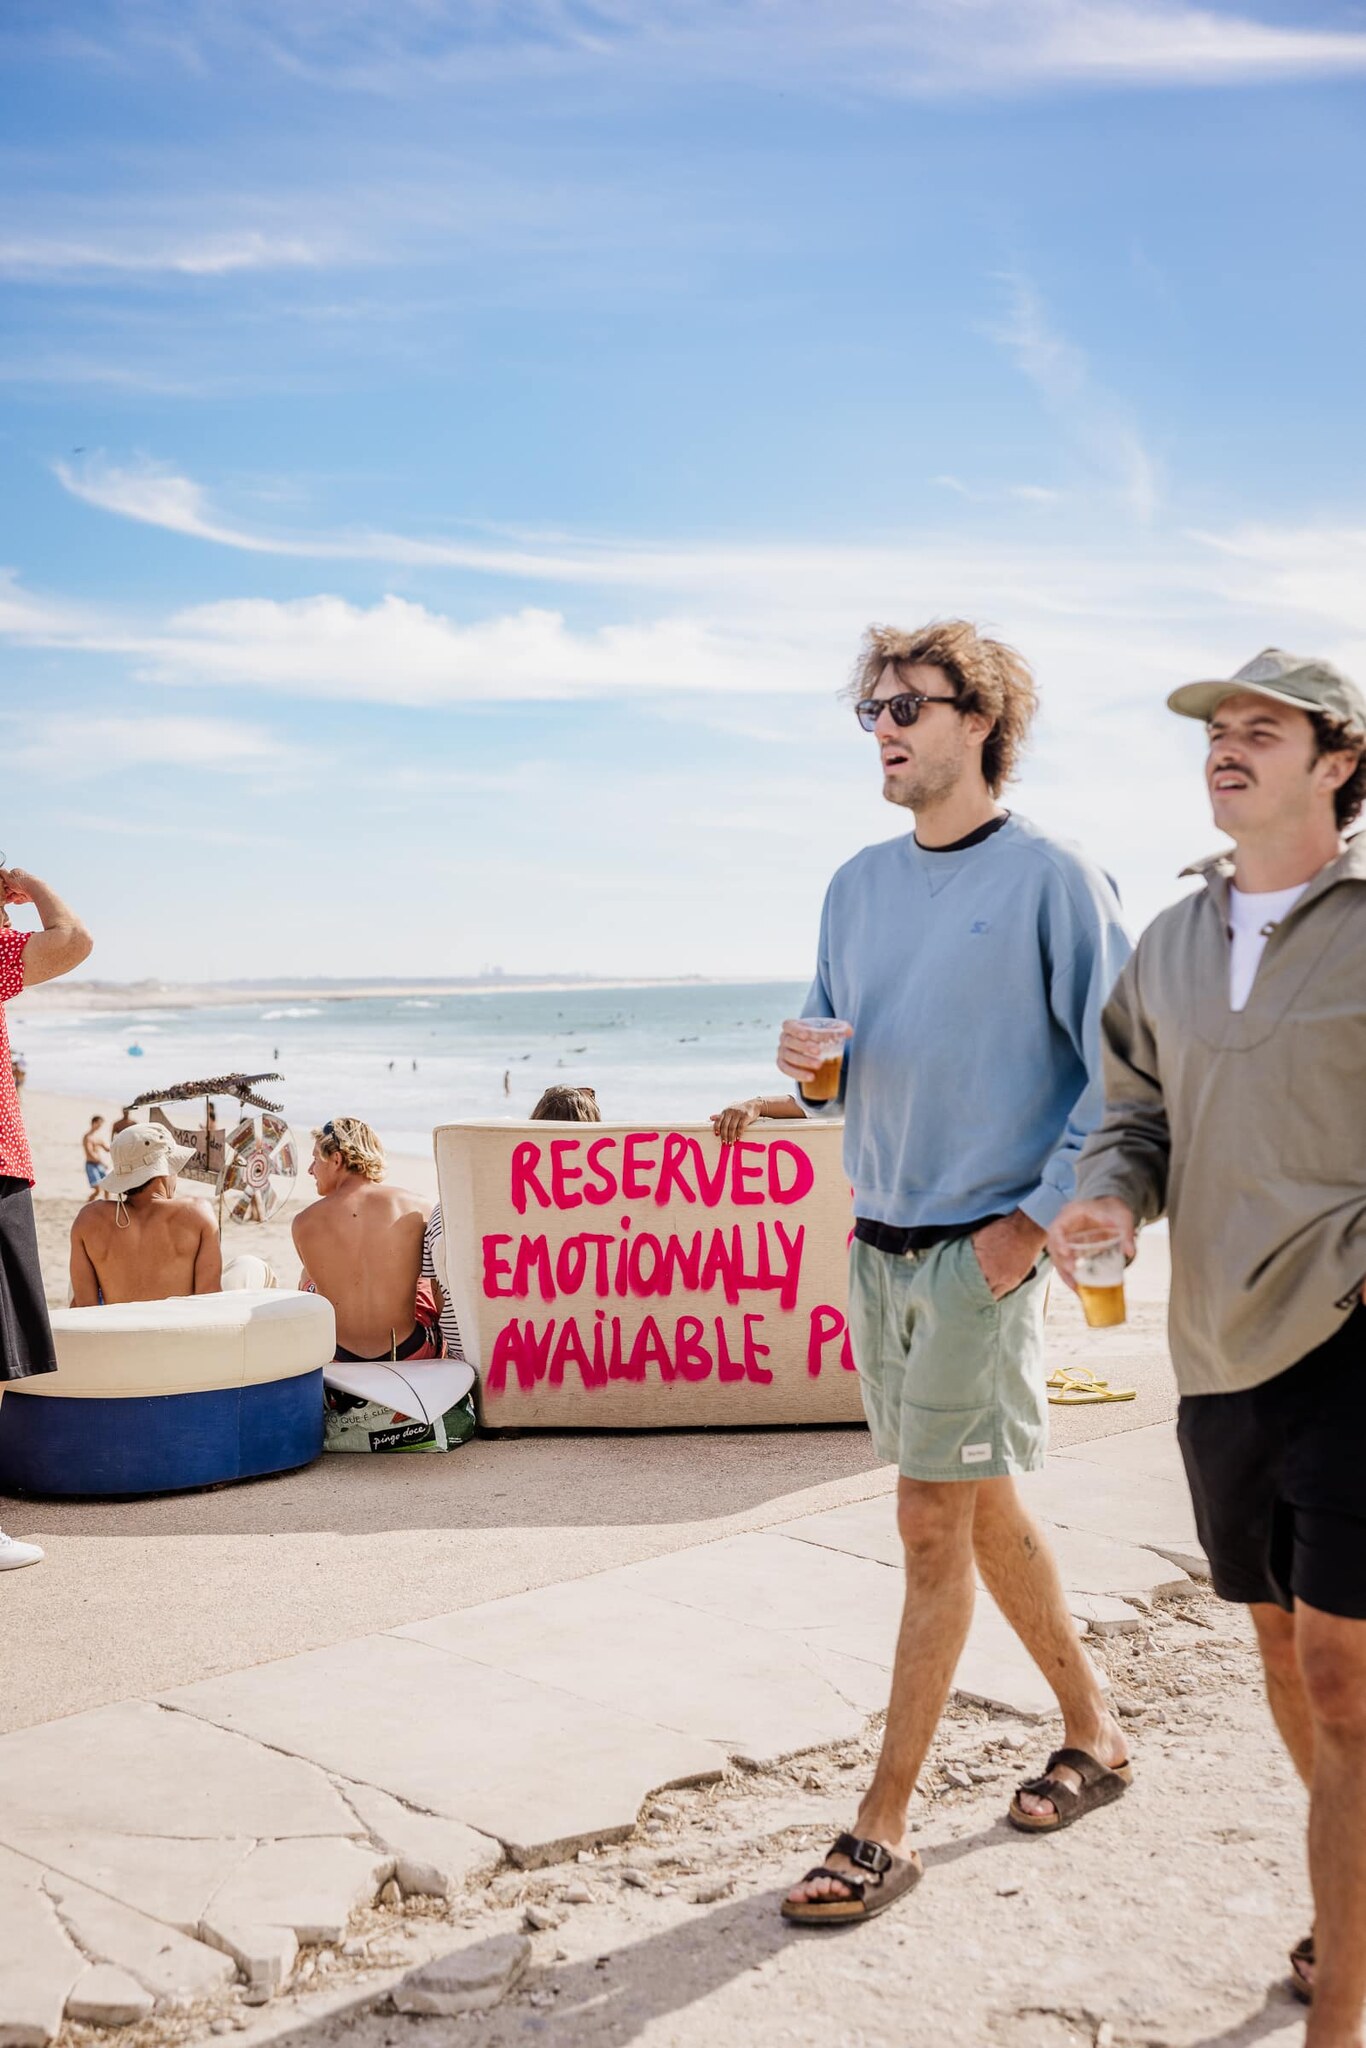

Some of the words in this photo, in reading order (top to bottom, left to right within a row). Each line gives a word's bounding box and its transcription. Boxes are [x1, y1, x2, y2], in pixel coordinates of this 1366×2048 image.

[511, 1132, 814, 1214] RESERVED
[340, 1415, 361, 1424] QUE
[373, 1432, 401, 1450] pingo
[402, 1425, 427, 1438] doce
